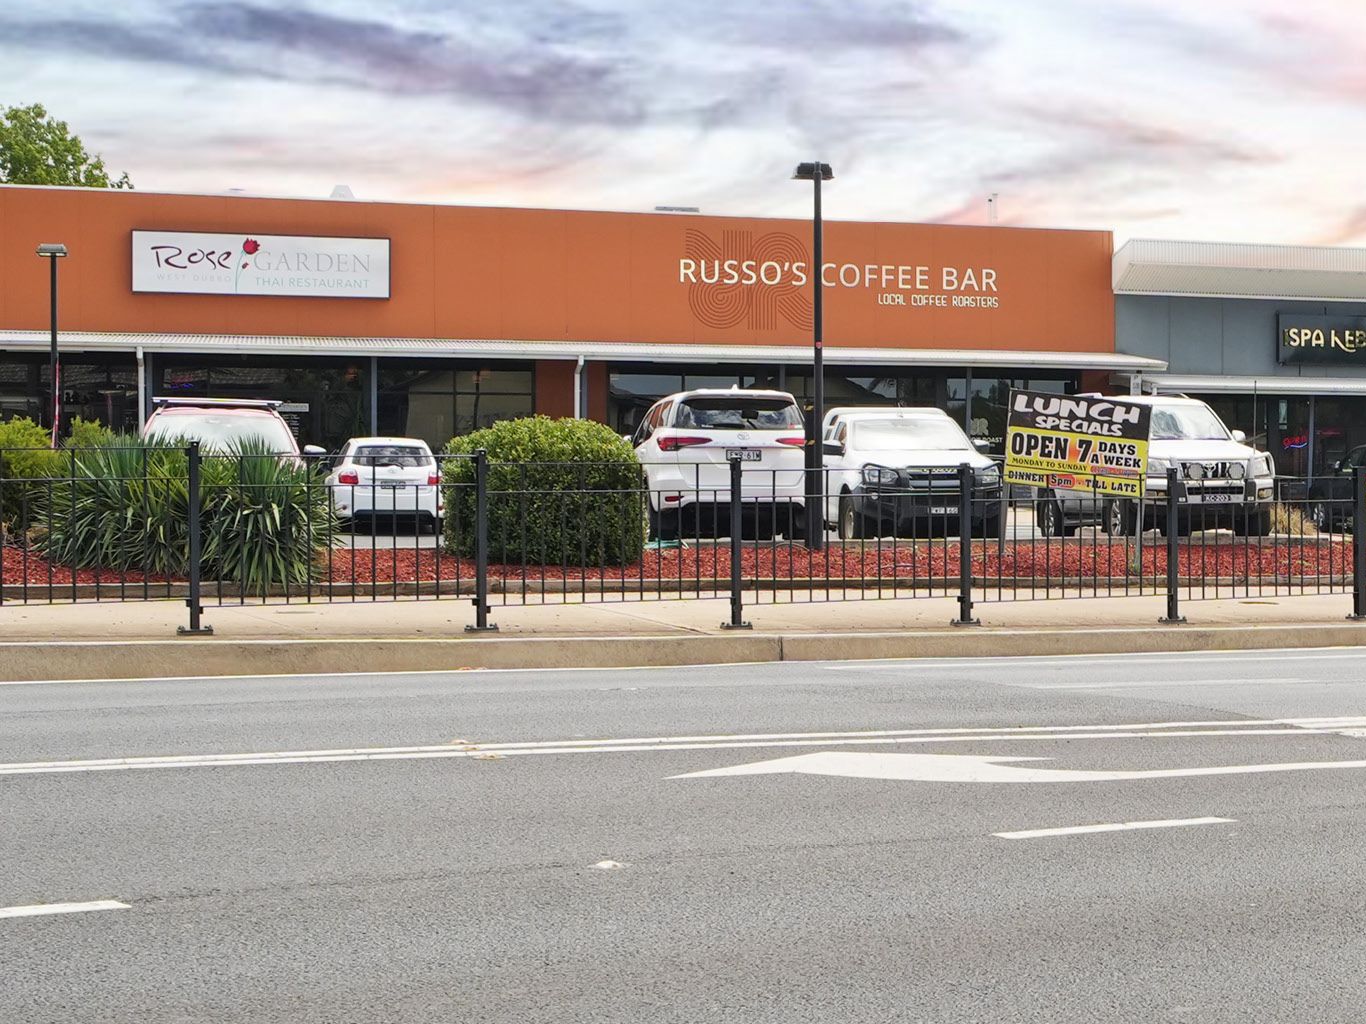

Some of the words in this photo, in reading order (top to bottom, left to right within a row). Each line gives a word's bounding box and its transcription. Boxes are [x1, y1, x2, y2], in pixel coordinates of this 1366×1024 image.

[150, 244, 232, 270] Rose
[253, 251, 371, 273] GARDEN
[255, 276, 285, 287] THAI
[289, 277, 370, 289] RESTAURANT
[678, 258, 808, 287] RUSSO'S
[820, 262, 930, 291] COFFEE
[941, 266, 998, 293] BAR
[877, 293, 907, 306] LOCAL
[911, 294, 948, 307] COFFEE
[951, 295, 1000, 309] ROASTERS
[1013, 394, 1141, 424] LUNCH
[1034, 415, 1123, 436] SPECIALS
[1011, 432, 1070, 461] OPEN
[1077, 439, 1093, 463] 7
[1098, 441, 1137, 456] DAYS
[1011, 456, 1045, 468] MONDAY
[1046, 461, 1056, 469] TO
[1056, 462, 1088, 472] SUNDAY
[1091, 453, 1100, 465] A
[1104, 454, 1142, 468] WEEK
[1007, 470, 1045, 483] DINNER
[1050, 474, 1073, 486] 5pm
[1110, 481, 1137, 493] LATE
